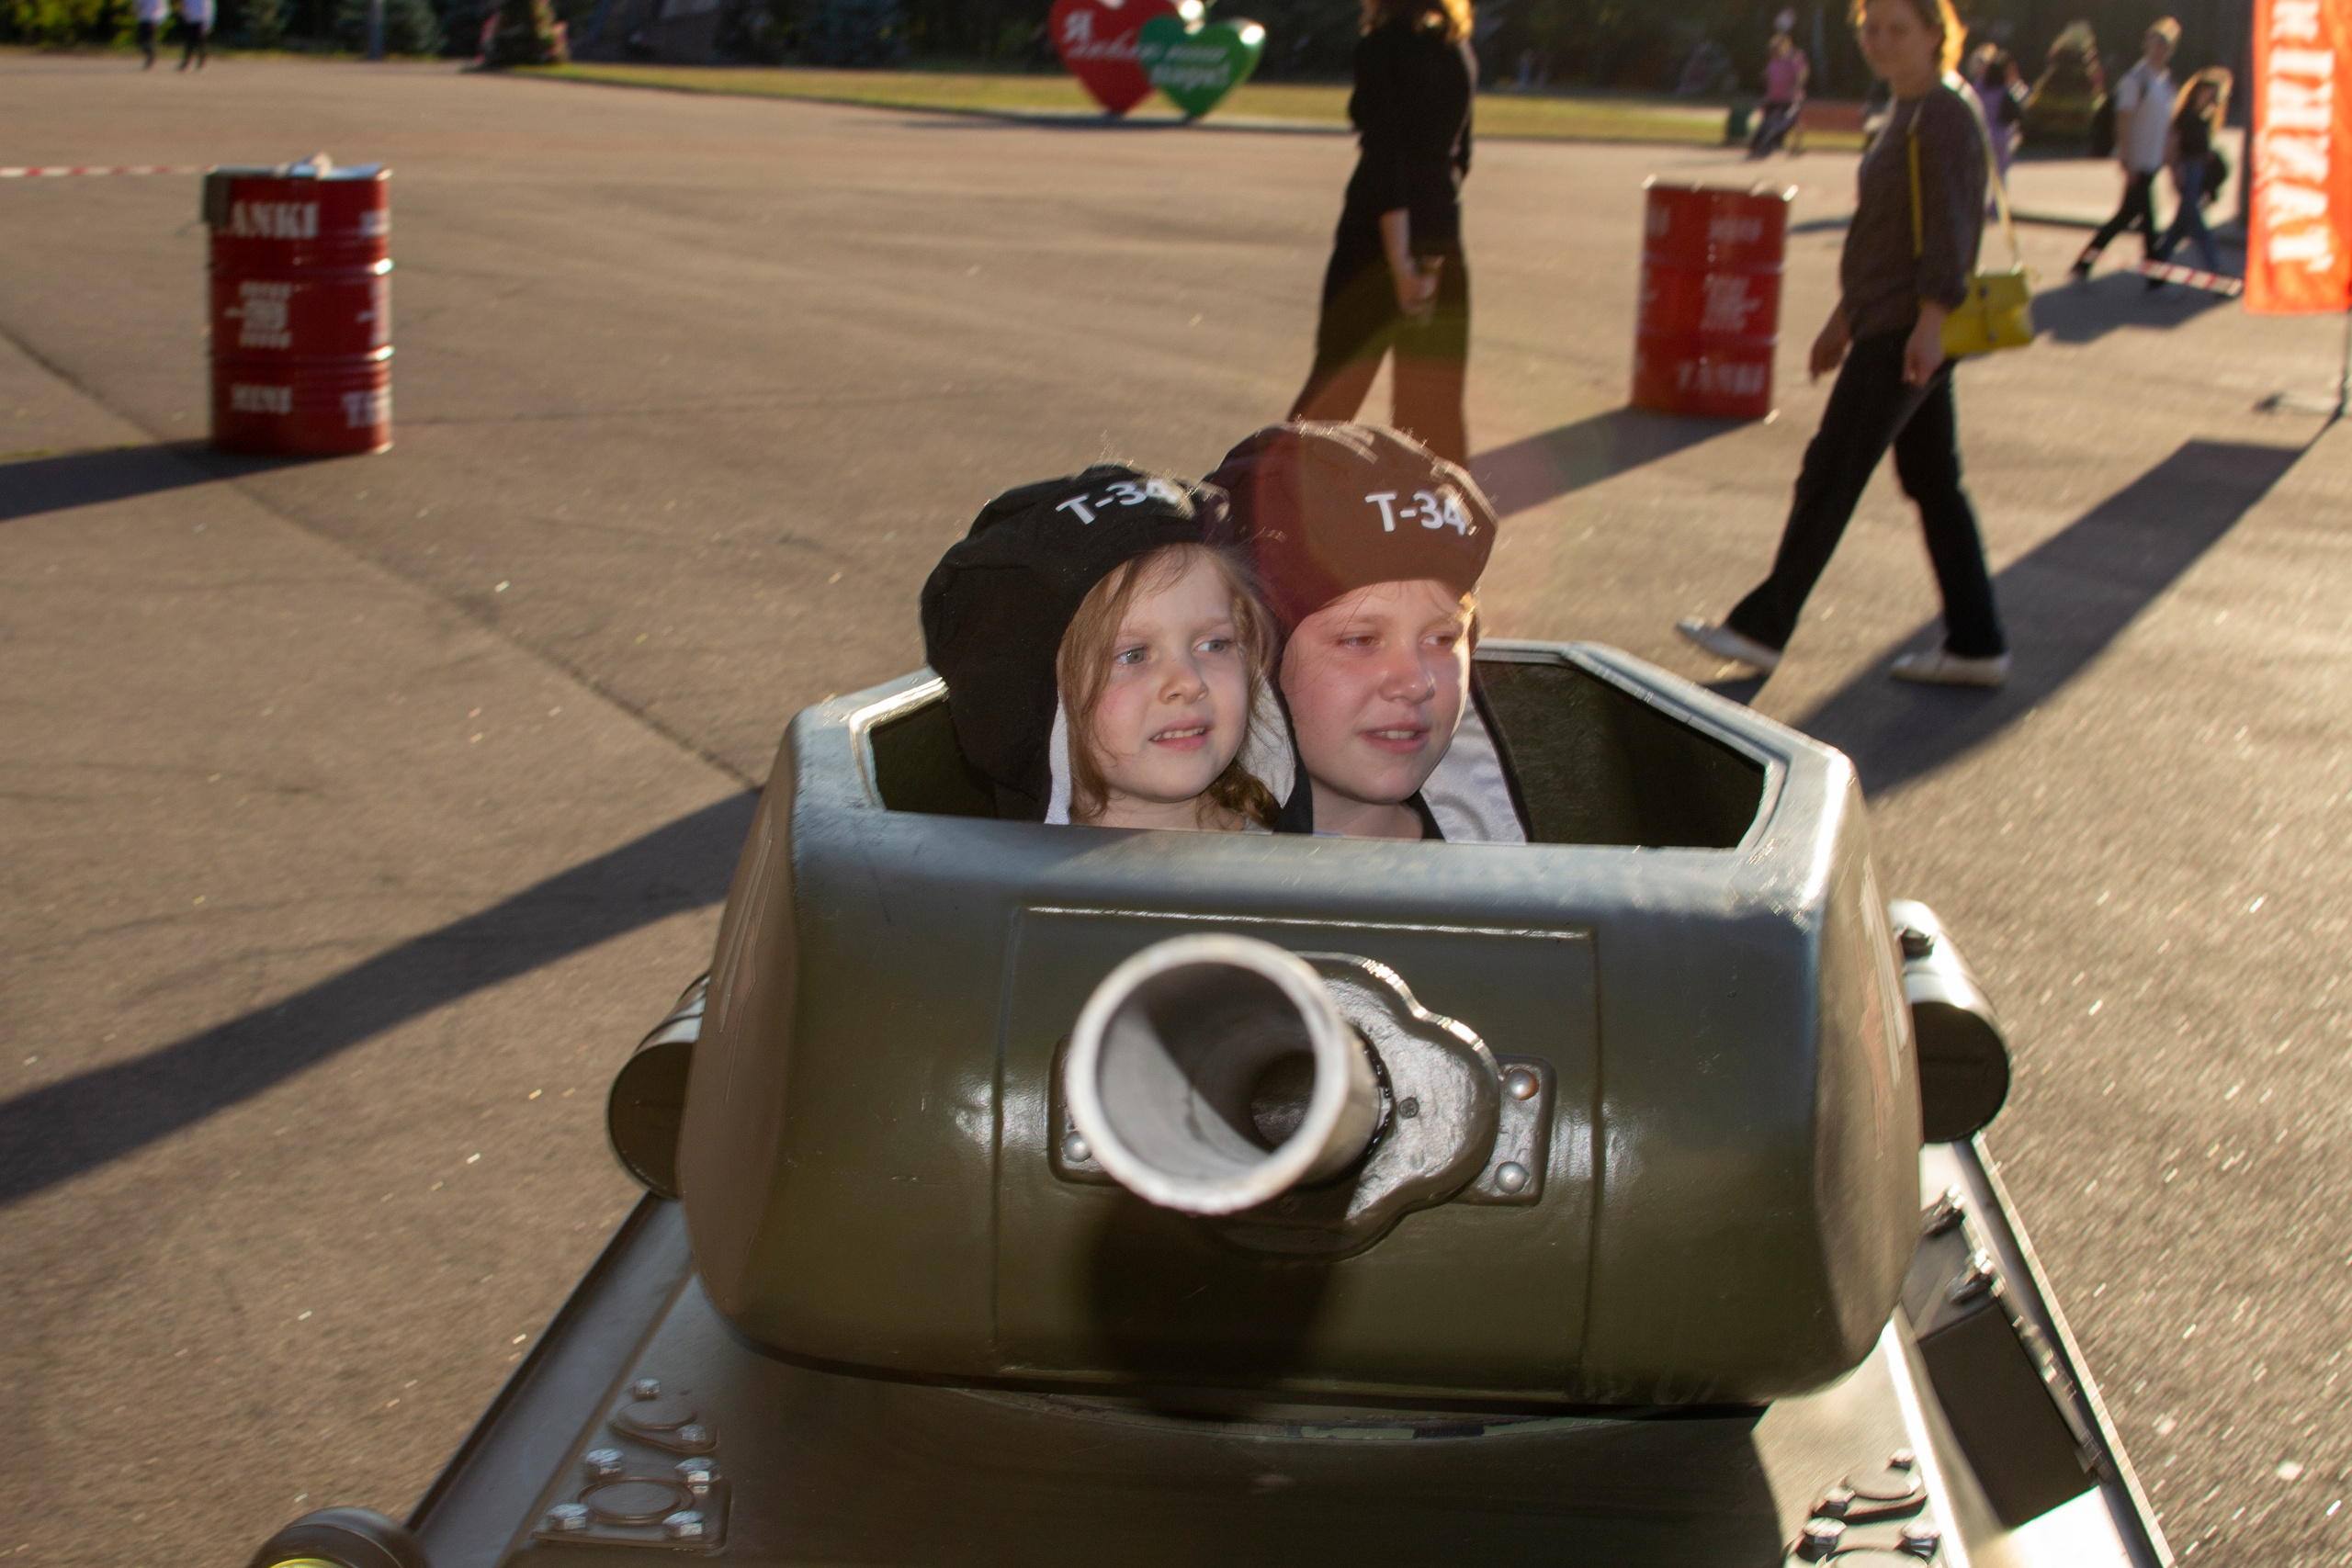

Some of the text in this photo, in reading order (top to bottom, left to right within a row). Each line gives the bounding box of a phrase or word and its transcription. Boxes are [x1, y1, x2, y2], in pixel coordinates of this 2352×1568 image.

[217, 201, 319, 239] ANKI
[1056, 479, 1179, 525] T-34
[1364, 491, 1466, 536] T-34
